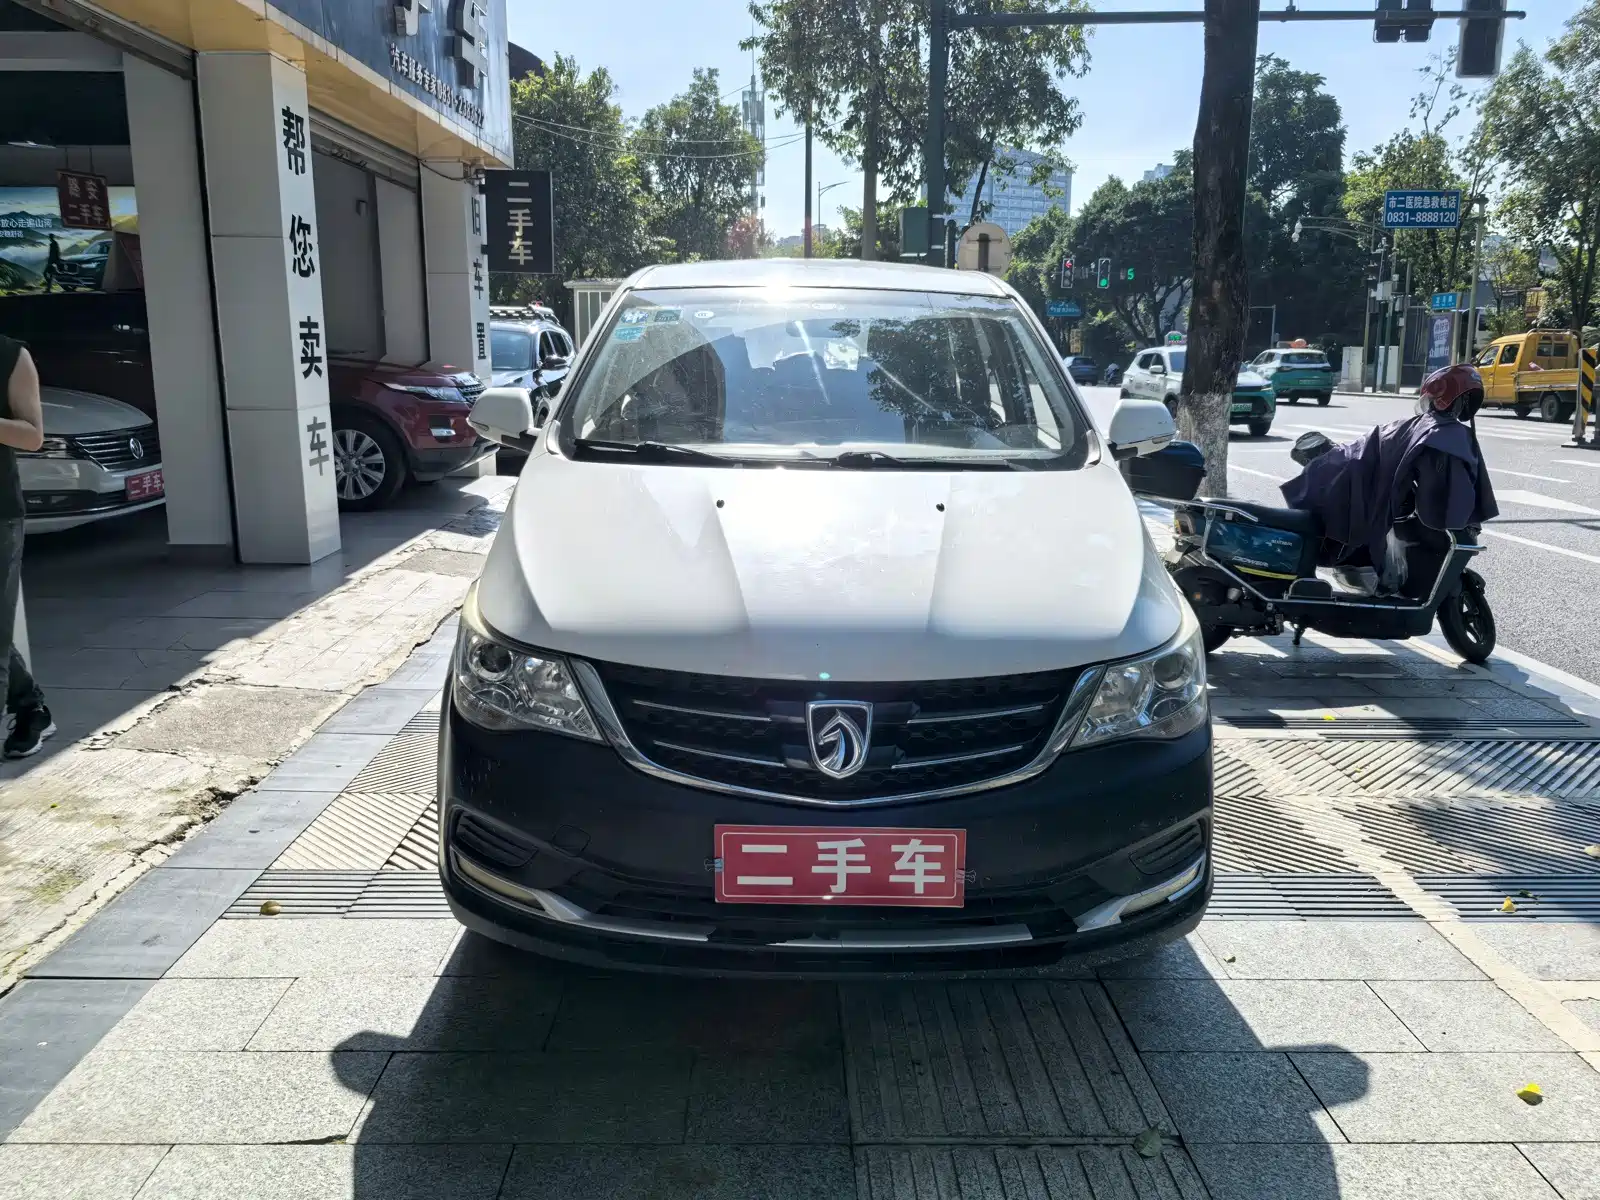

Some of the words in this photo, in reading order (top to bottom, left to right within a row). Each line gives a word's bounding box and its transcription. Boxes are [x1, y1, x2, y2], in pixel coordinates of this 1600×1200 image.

[1388, 196, 1457, 209] 市二医院急救电话
[507, 181, 534, 265] 二手车
[1387, 212, 1456, 223] 0831-8888120
[1127, 268, 1135, 280] 5
[281, 105, 330, 477] 帮您卖车
[131, 473, 161, 494] 二手车
[737, 838, 945, 894] 二手车
